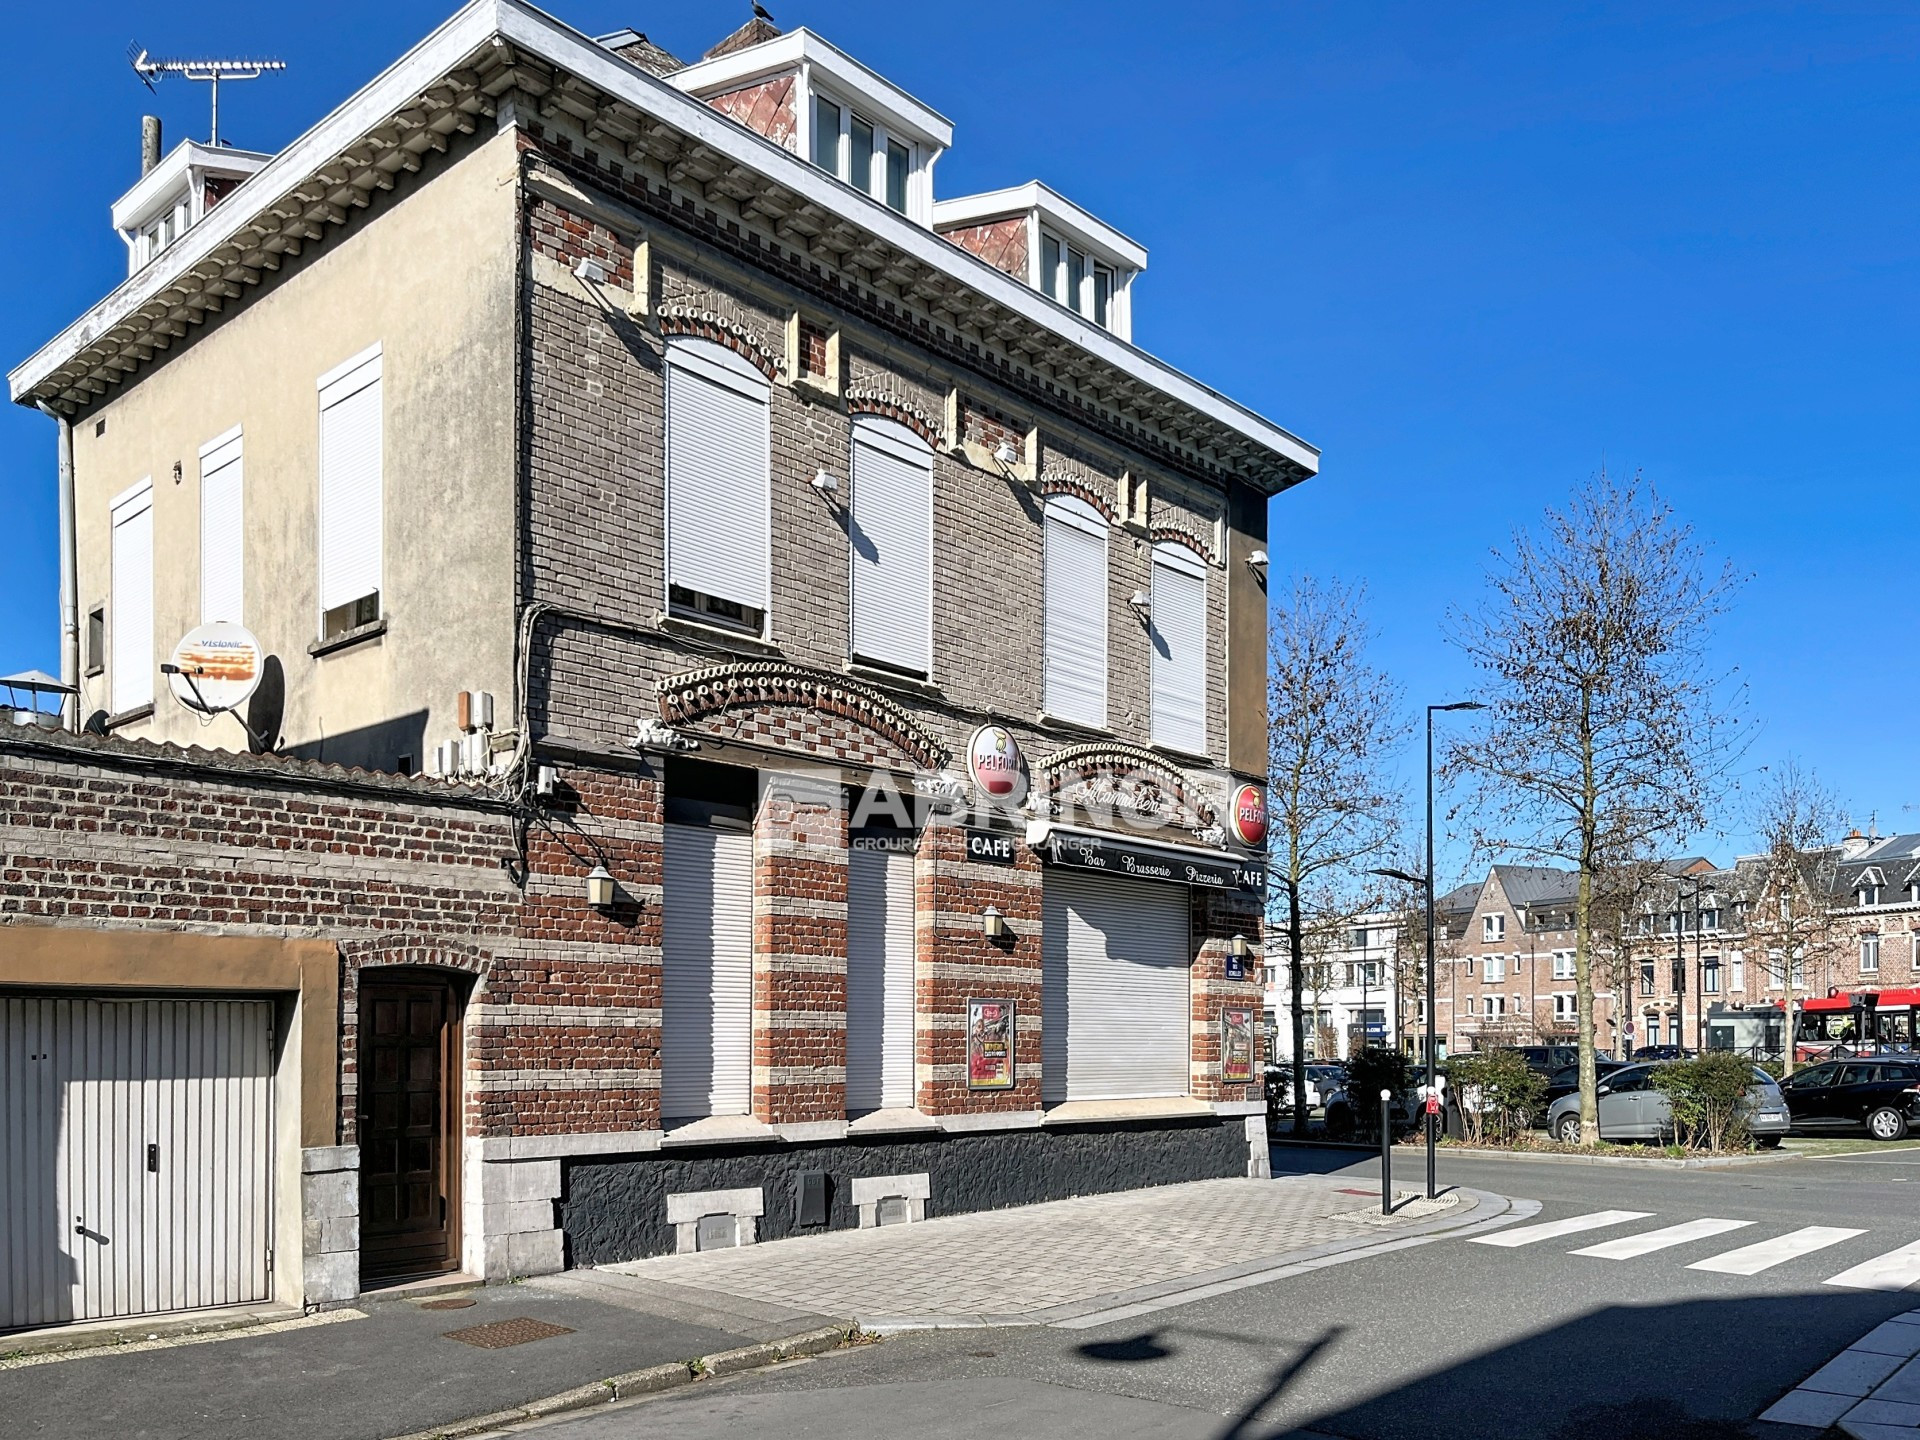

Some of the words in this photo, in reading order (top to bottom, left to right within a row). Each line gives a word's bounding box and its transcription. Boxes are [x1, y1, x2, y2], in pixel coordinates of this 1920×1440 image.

[971, 836, 1010, 858] CAFE
[1079, 847, 1106, 868] Bar
[1121, 855, 1171, 877] Brasserie
[1185, 865, 1224, 885] Pizzeria
